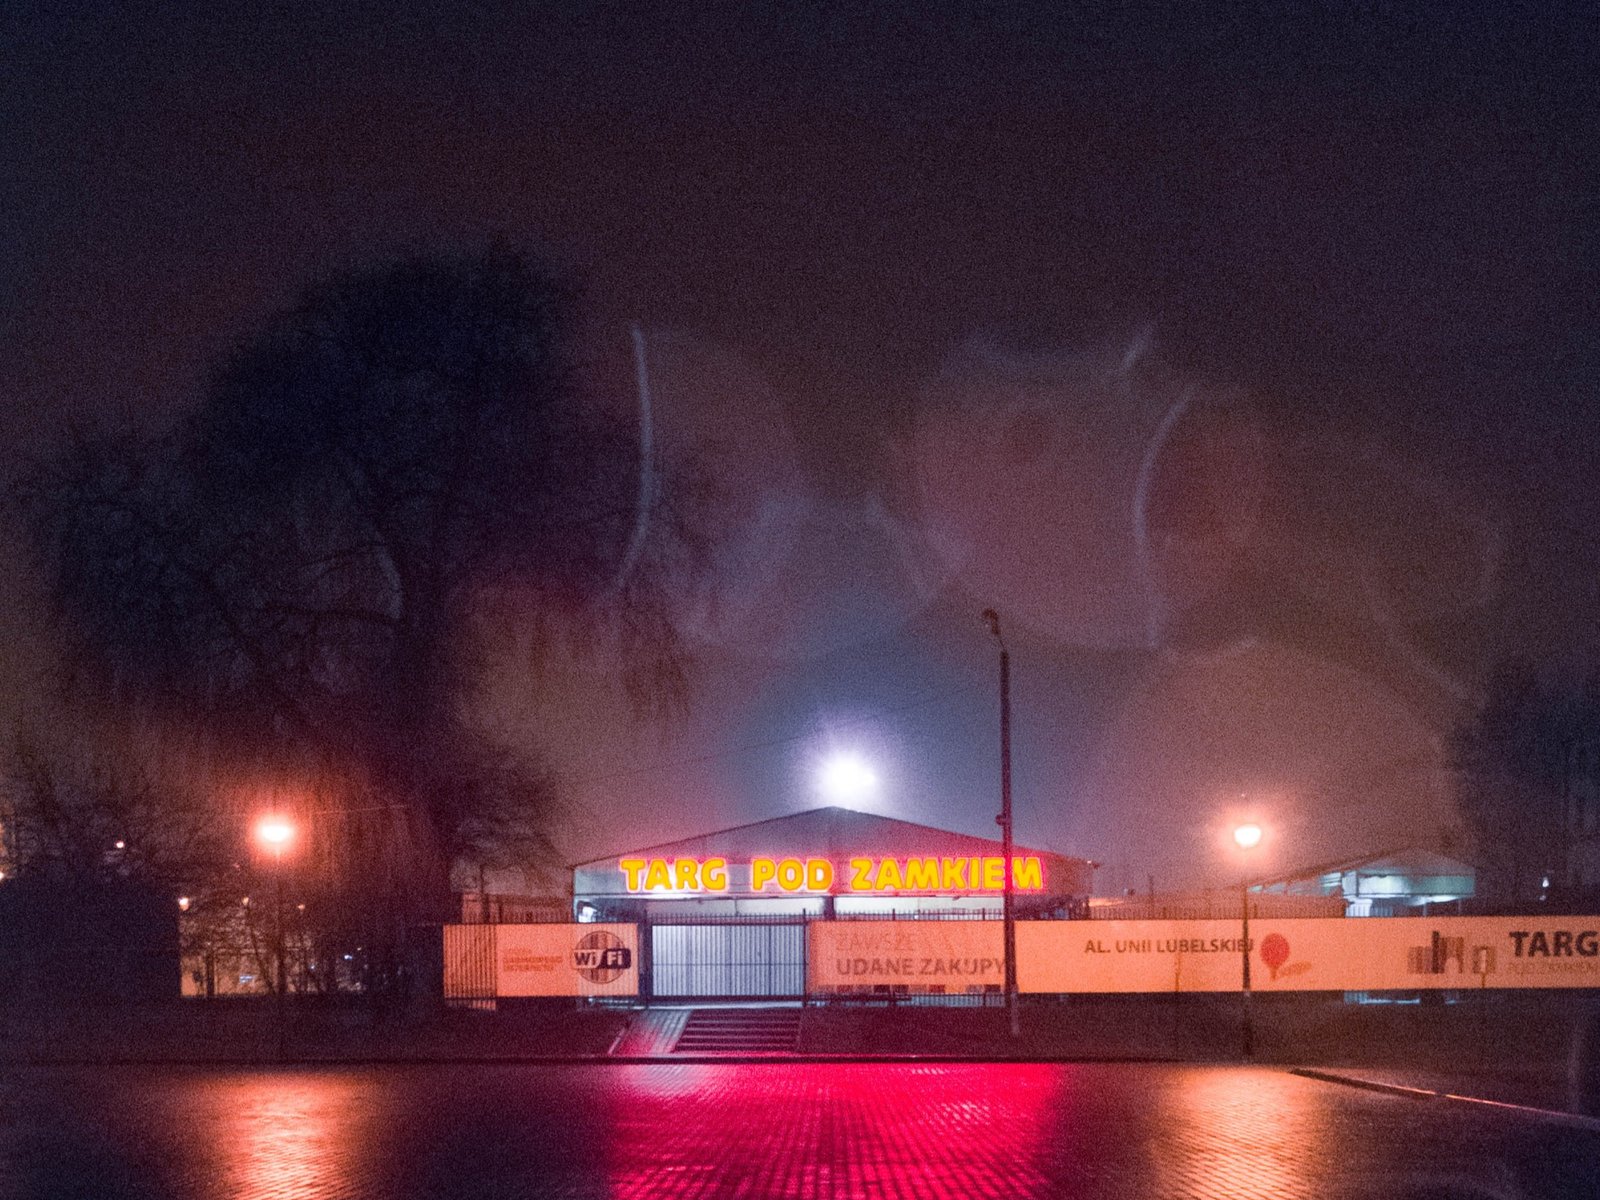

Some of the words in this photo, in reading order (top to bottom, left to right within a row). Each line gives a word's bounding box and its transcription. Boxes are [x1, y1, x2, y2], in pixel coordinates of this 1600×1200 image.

[620, 858, 726, 892] TARG
[751, 858, 833, 892] POD
[850, 857, 1043, 890] ZAMKIEM
[1085, 939, 1111, 954] AL.
[1116, 939, 1151, 954] UNII
[1508, 930, 1599, 957] TARG
[836, 957, 915, 976] UDANE
